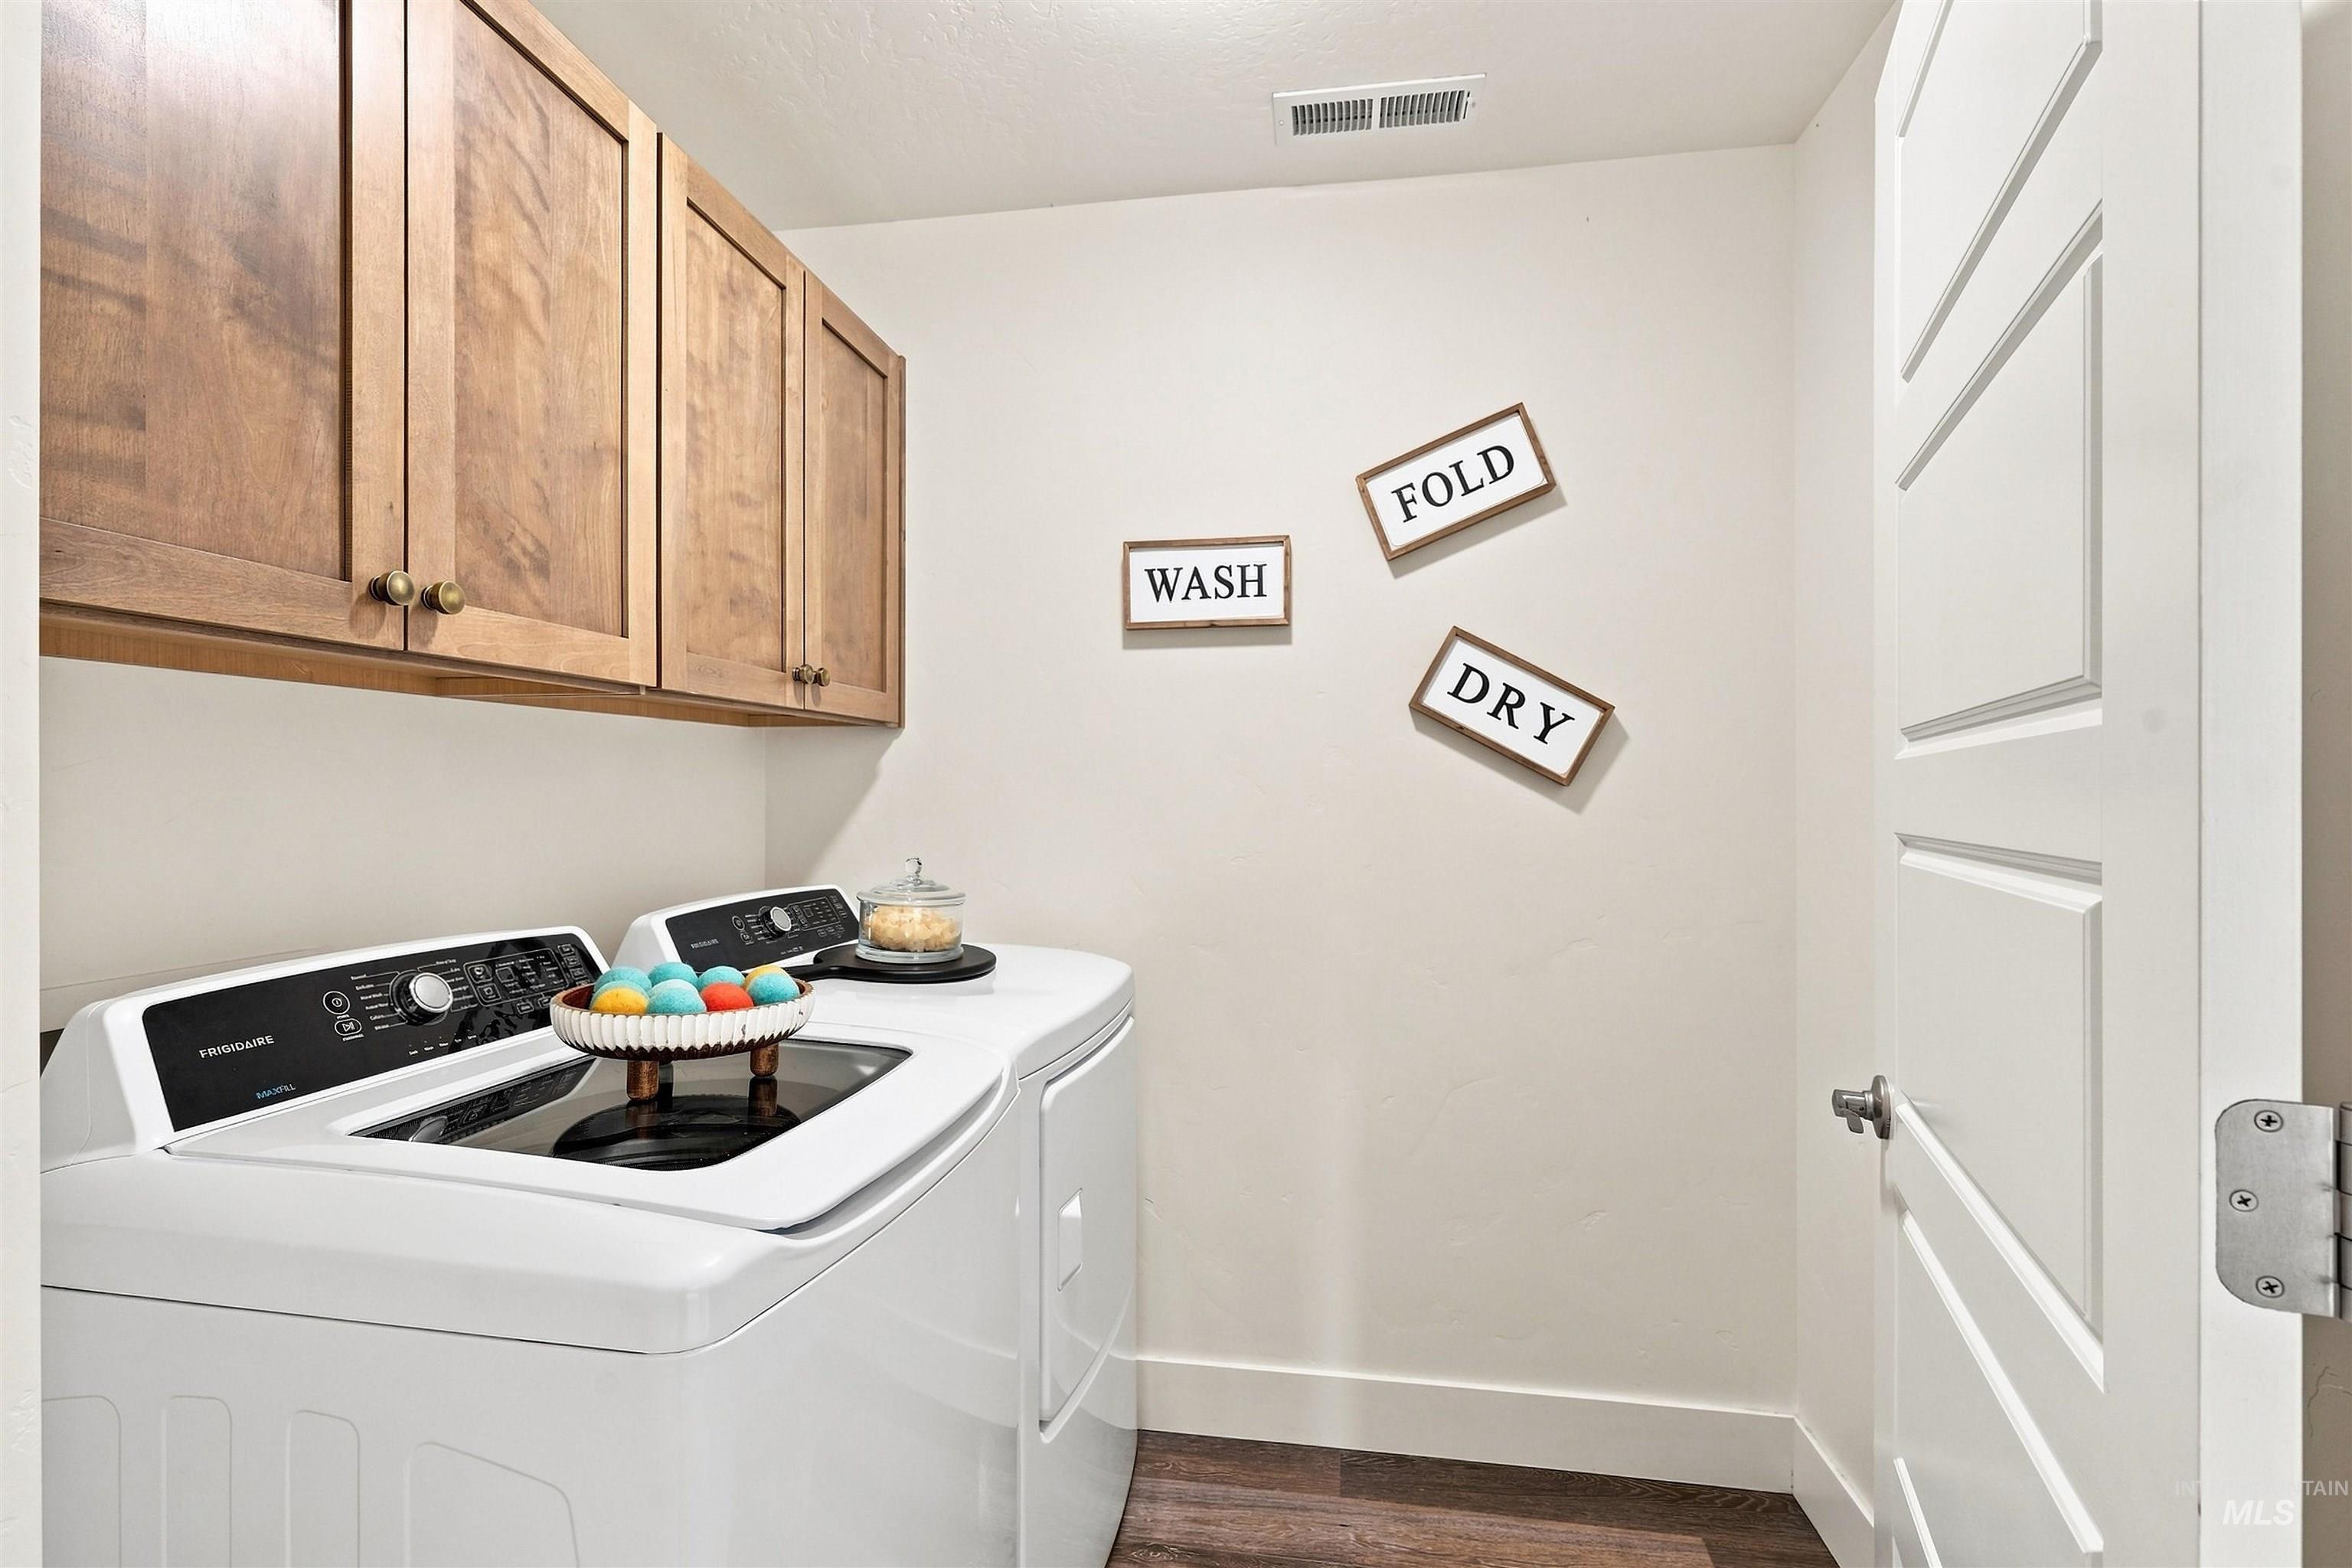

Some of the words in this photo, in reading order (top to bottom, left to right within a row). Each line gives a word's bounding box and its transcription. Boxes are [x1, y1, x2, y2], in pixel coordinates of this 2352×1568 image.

[1391, 446, 1514, 522] FOLD
[1145, 564, 1268, 603] WASH
[1447, 663, 1575, 744] DRY
[199, 1035, 275, 1059] FRIGIDAIRE
[256, 1083, 296, 1099] MAXFILL
